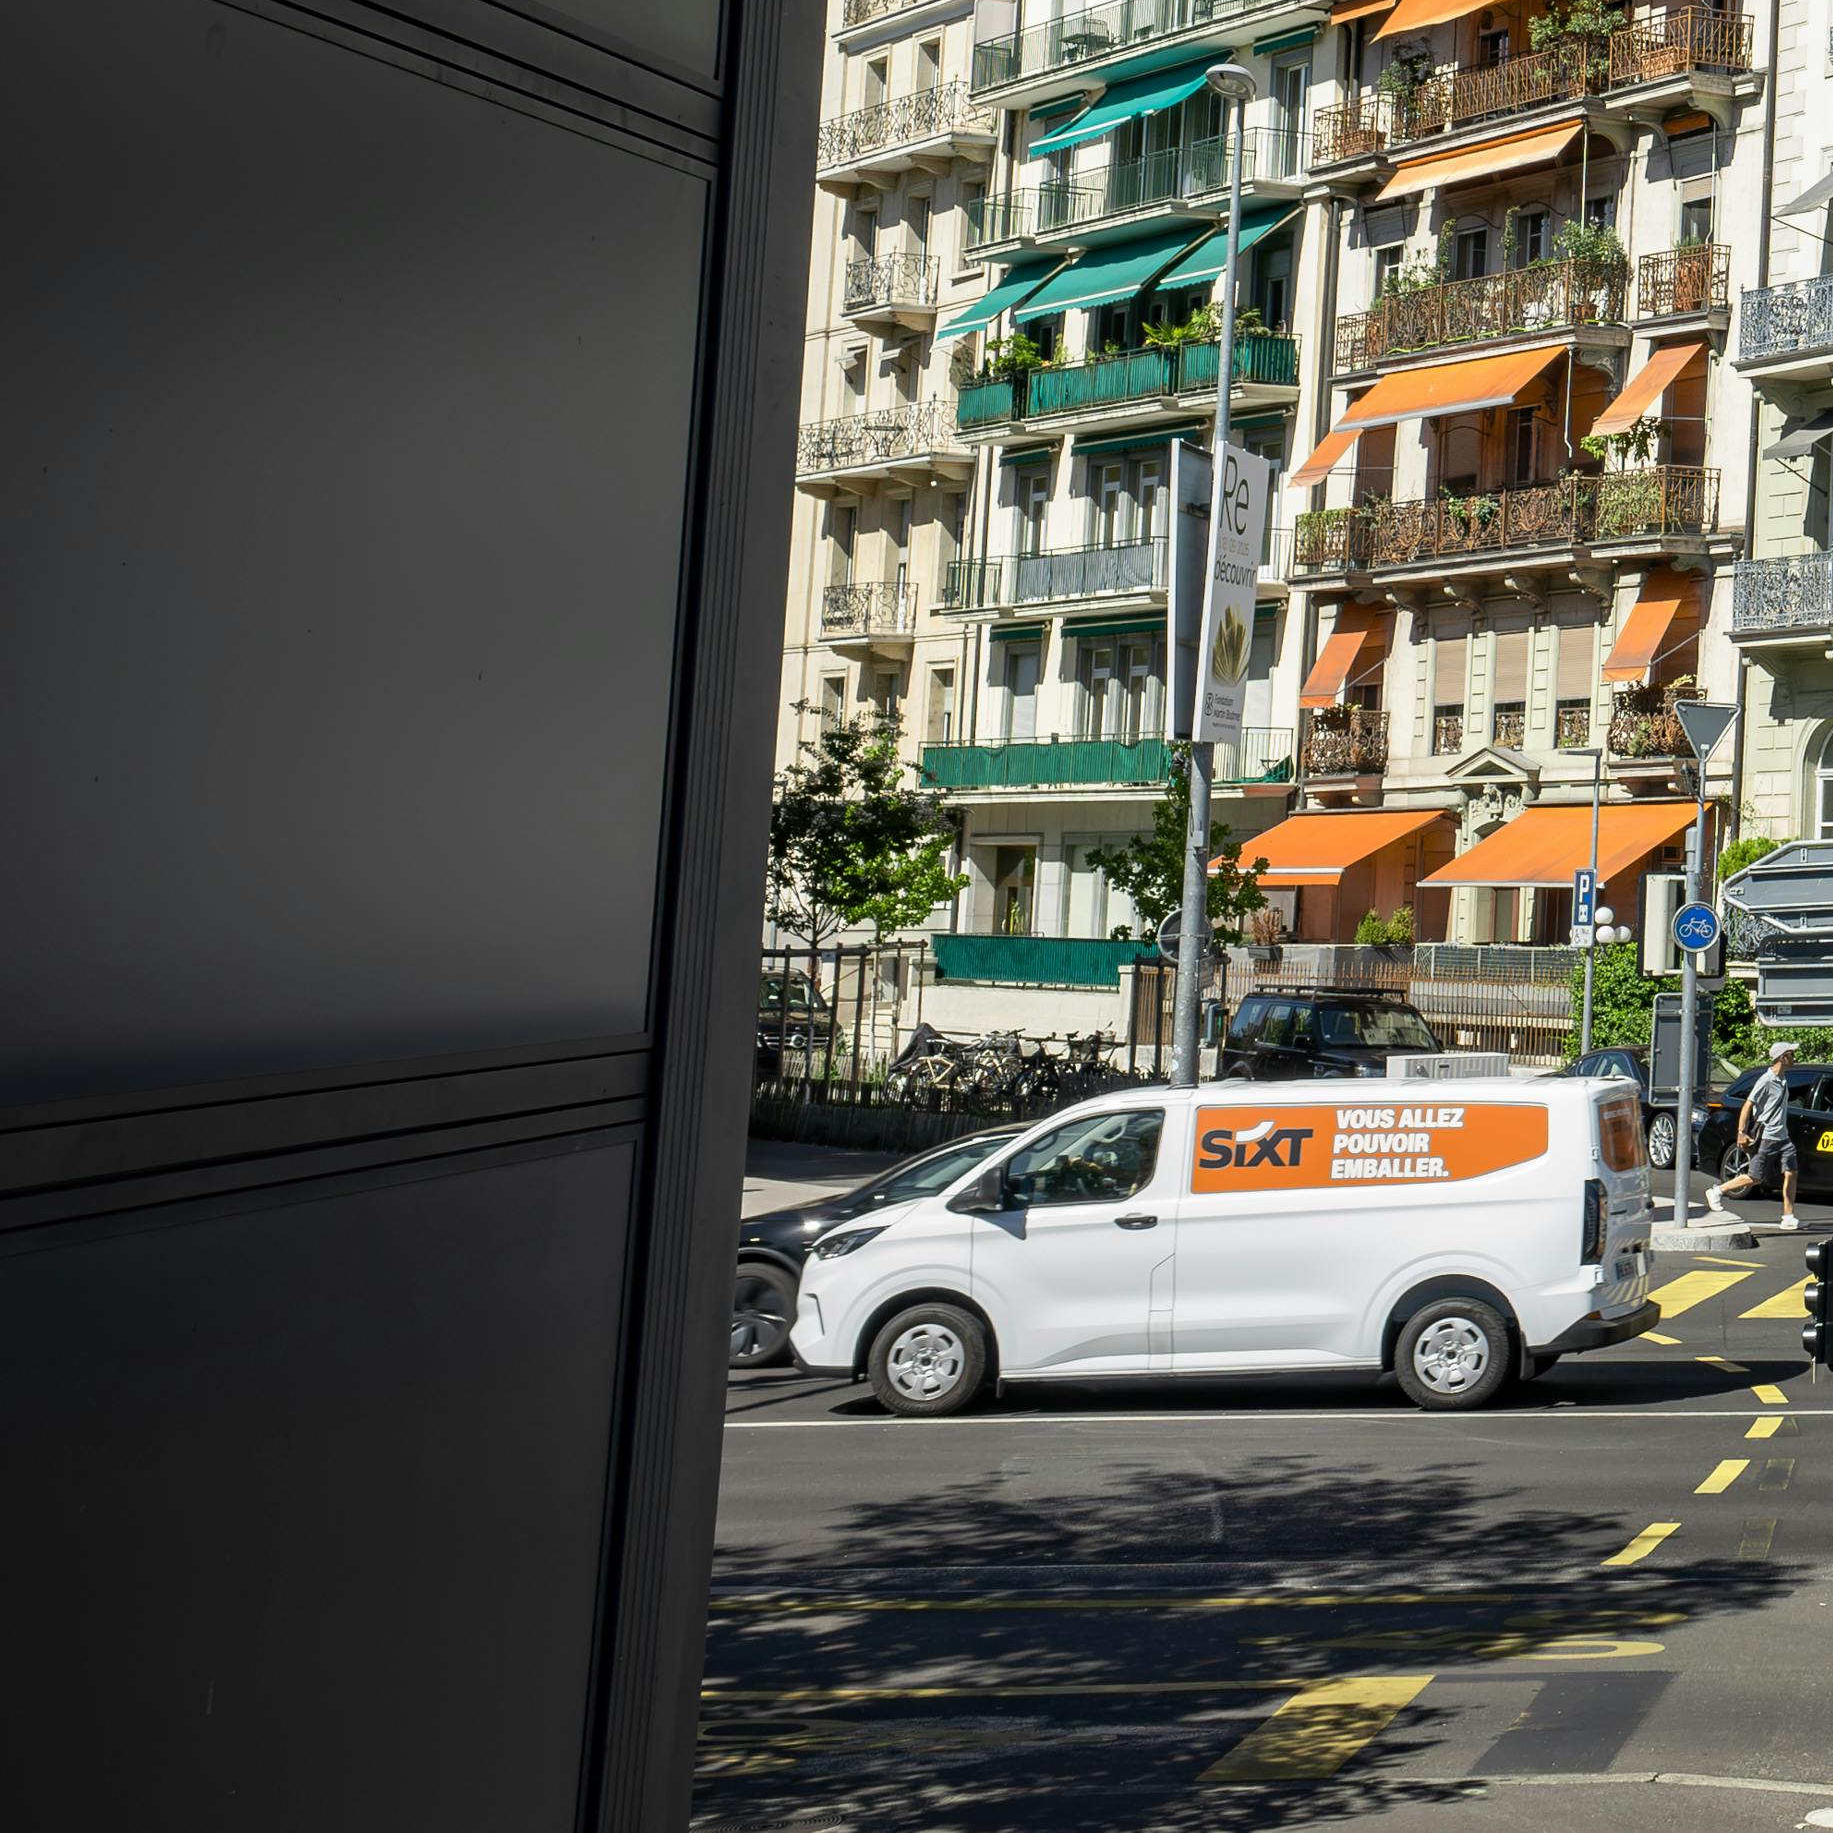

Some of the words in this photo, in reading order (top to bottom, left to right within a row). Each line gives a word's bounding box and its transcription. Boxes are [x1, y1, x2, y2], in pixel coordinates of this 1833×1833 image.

[1220, 454, 1249, 536] Re
[1215, 554, 1257, 588] découvrir
[1579, 874, 1590, 903] P
[1336, 1109, 1395, 1129] VOUS
[1398, 1108, 1465, 1128] ALLEZ
[1333, 1133, 1430, 1154] POUVOIR
[1331, 1158, 1449, 1179] EMBALLER.
